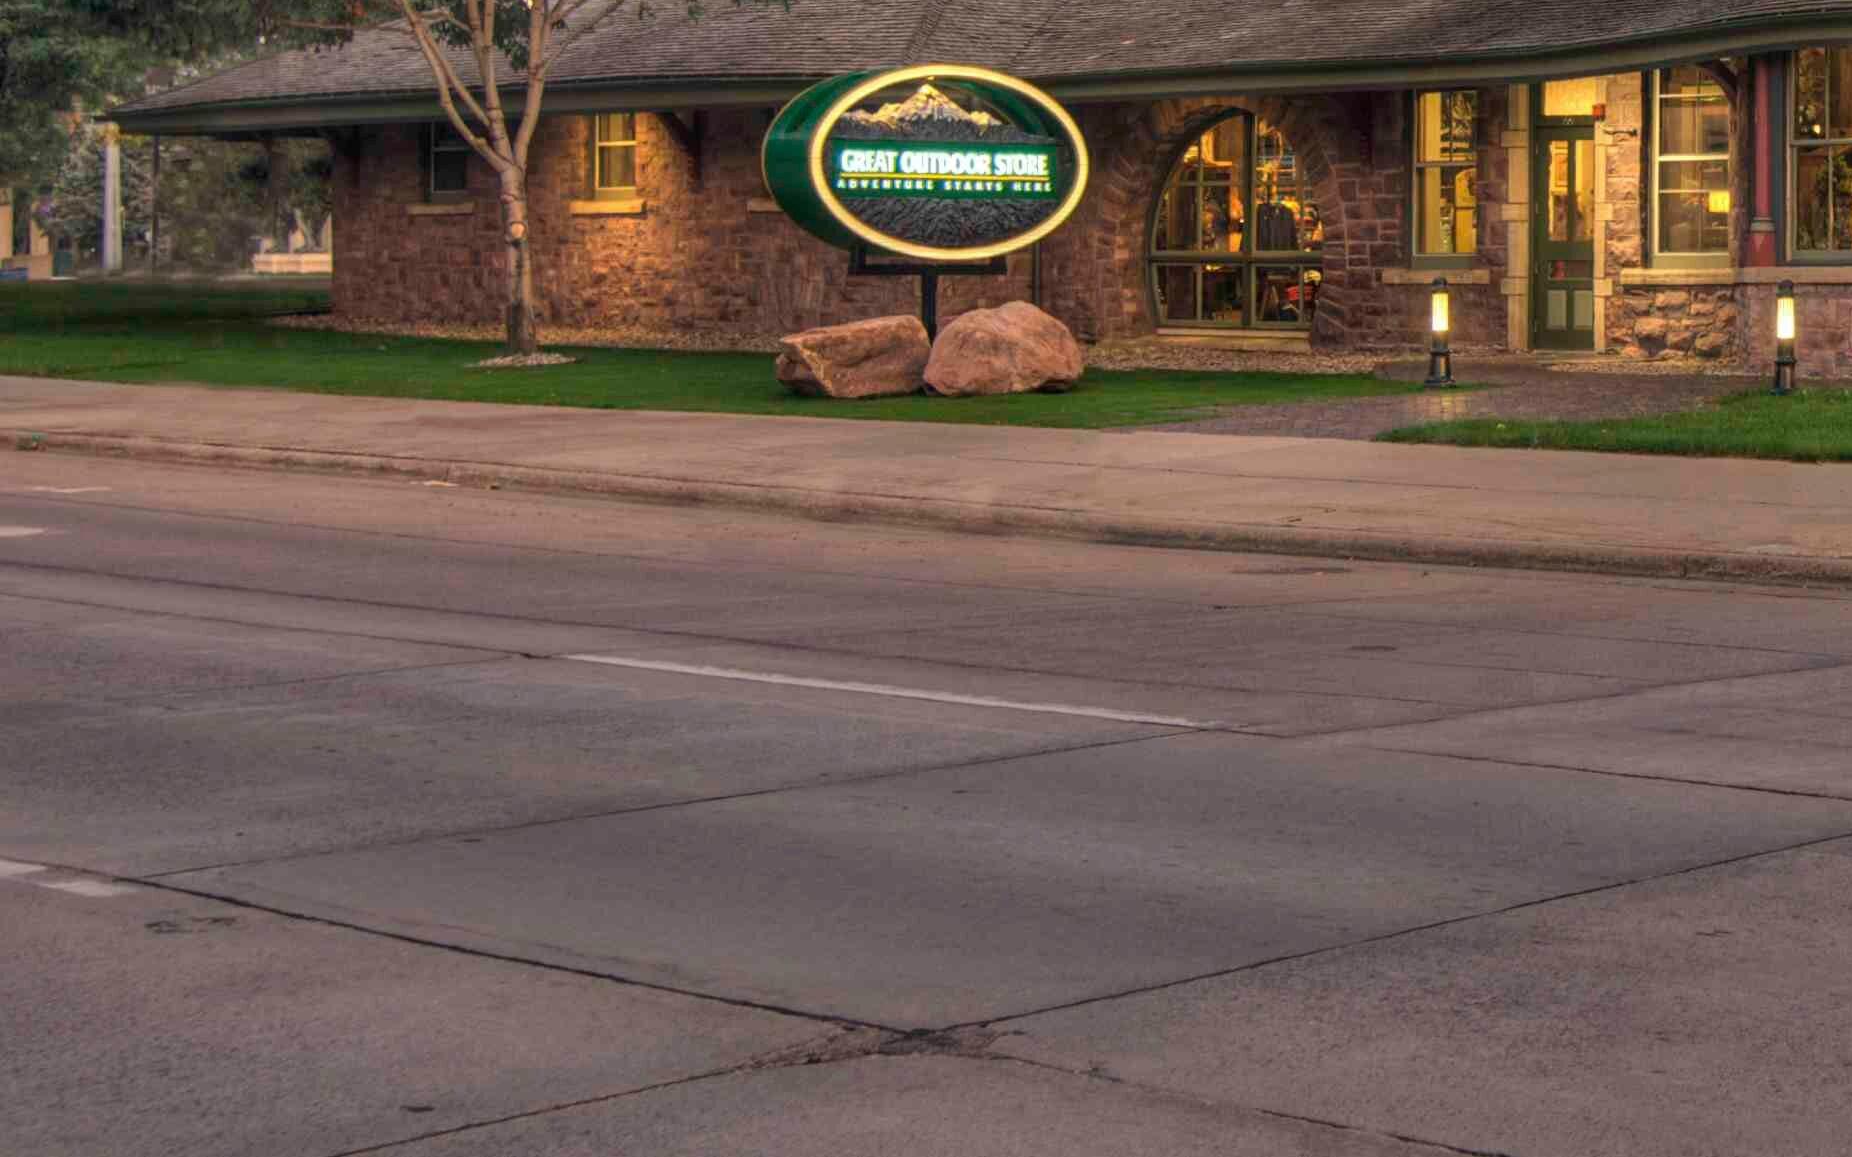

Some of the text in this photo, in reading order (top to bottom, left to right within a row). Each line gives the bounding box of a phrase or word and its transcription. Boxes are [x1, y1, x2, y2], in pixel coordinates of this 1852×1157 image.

[840, 149, 1049, 176] GREAT OUTDOOR STORE
[837, 179, 1052, 193] ADVENTURE STARTS HERE
